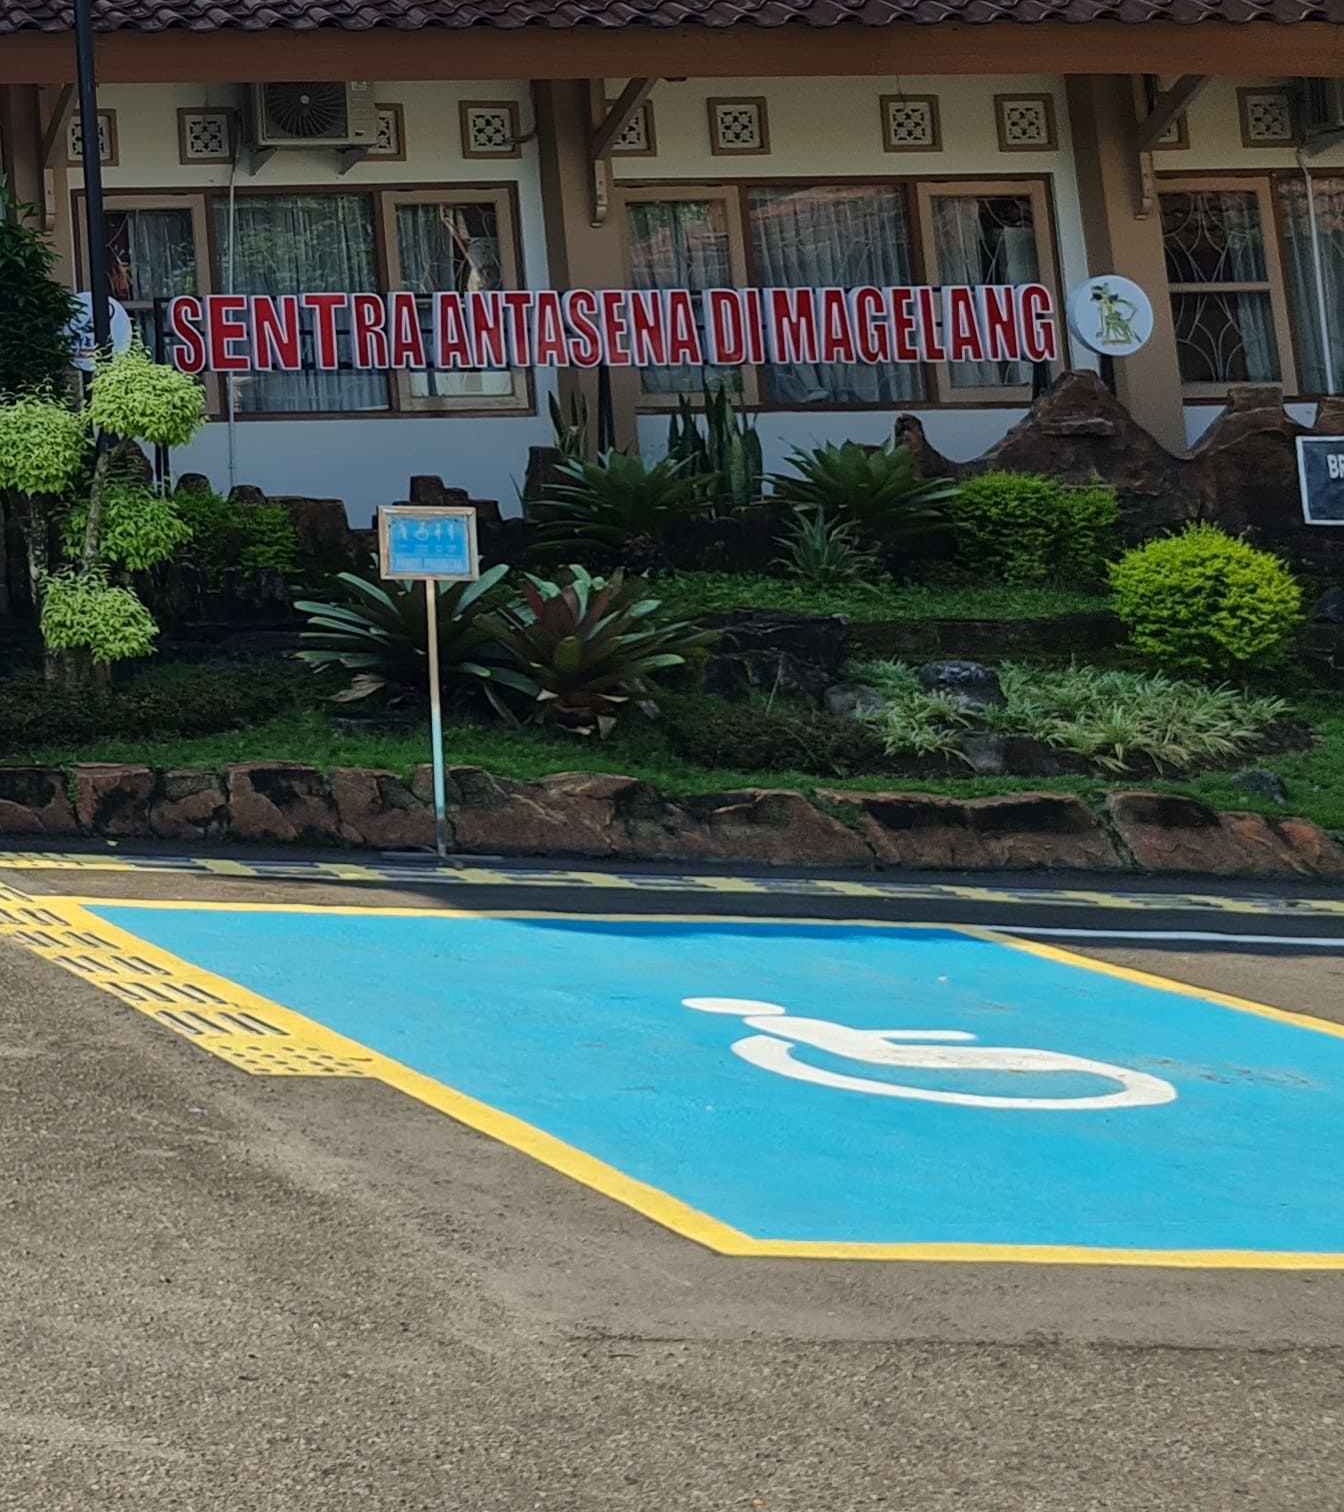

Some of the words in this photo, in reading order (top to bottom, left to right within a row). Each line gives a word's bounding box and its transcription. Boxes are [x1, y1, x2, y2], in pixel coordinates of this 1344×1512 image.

[169, 291, 425, 374] SENTRA
[434, 289, 702, 369] ANTASENA
[707, 288, 765, 365] DI
[767, 284, 1057, 365] MAGELANG
